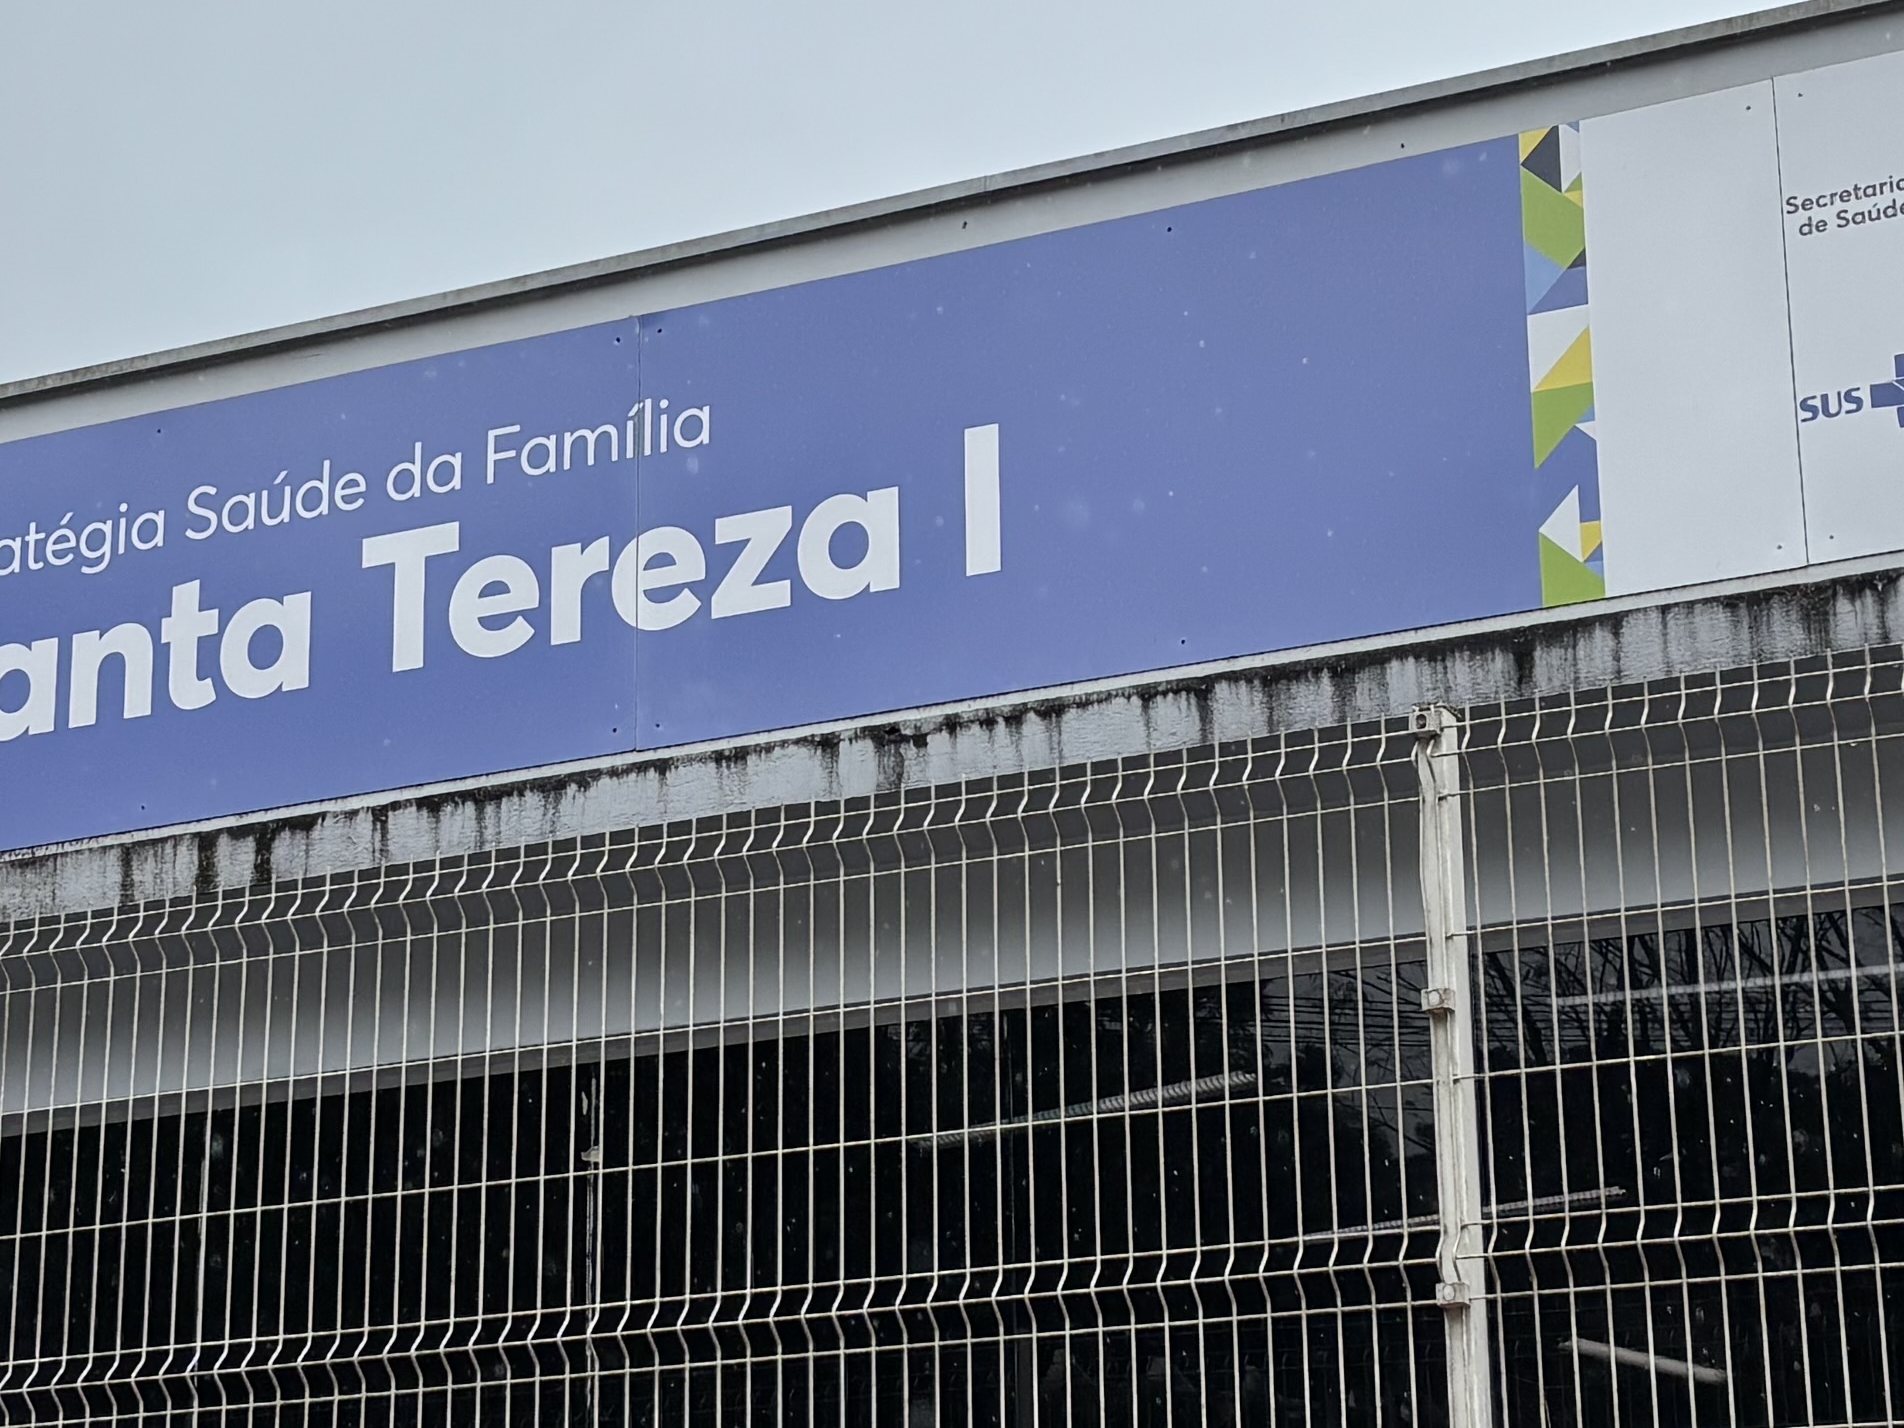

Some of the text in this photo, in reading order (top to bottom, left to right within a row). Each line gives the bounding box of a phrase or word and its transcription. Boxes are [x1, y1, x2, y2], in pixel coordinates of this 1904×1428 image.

[1798, 215, 1829, 237] de
[1798, 386, 1865, 423] SUS
[185, 458, 366, 541] Saúde
[386, 441, 464, 502] da
[485, 396, 712, 485] Família
[361, 485, 901, 674] Tereza
[964, 421, 1003, 577] I
